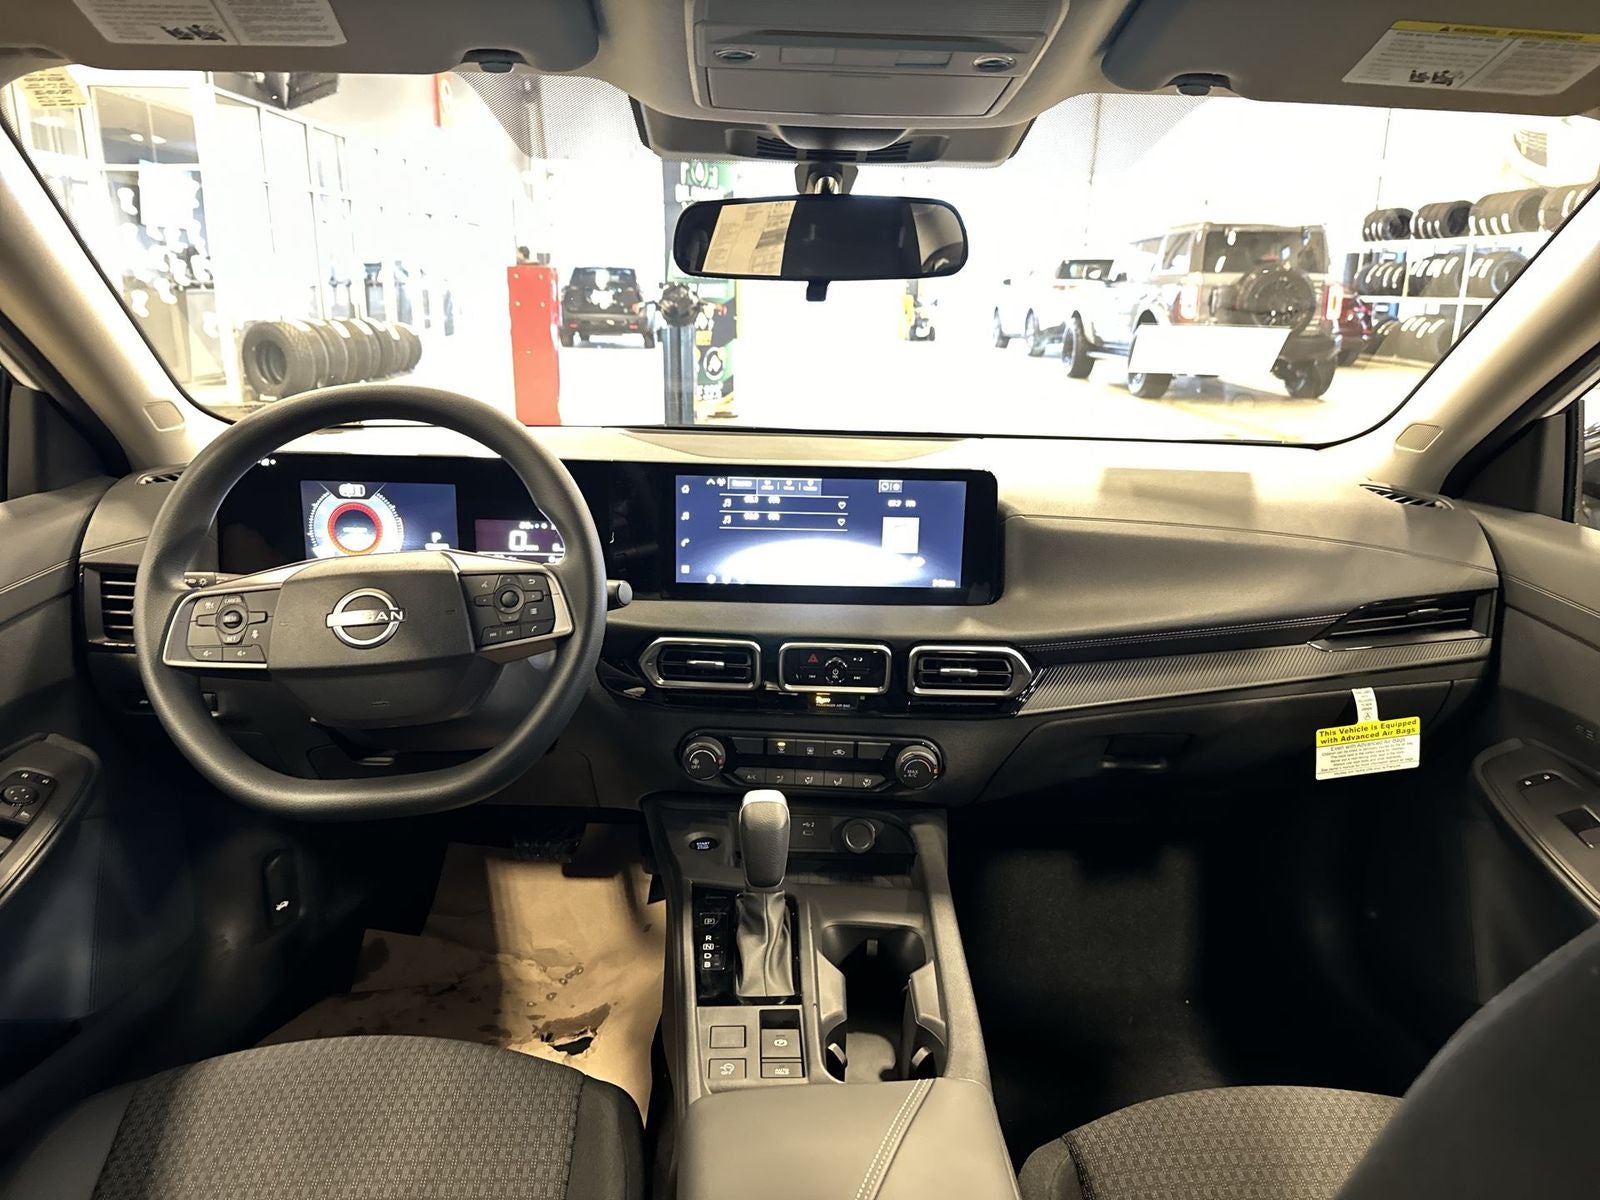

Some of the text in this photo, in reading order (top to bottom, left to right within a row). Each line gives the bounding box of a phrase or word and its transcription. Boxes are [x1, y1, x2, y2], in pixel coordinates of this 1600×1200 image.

[1319, 729, 1337, 737] This
[1339, 725, 1369, 735] Vehicle
[1380, 719, 1417, 730] Equipped
[1320, 727, 1416, 745] with Advanced Air Bags
